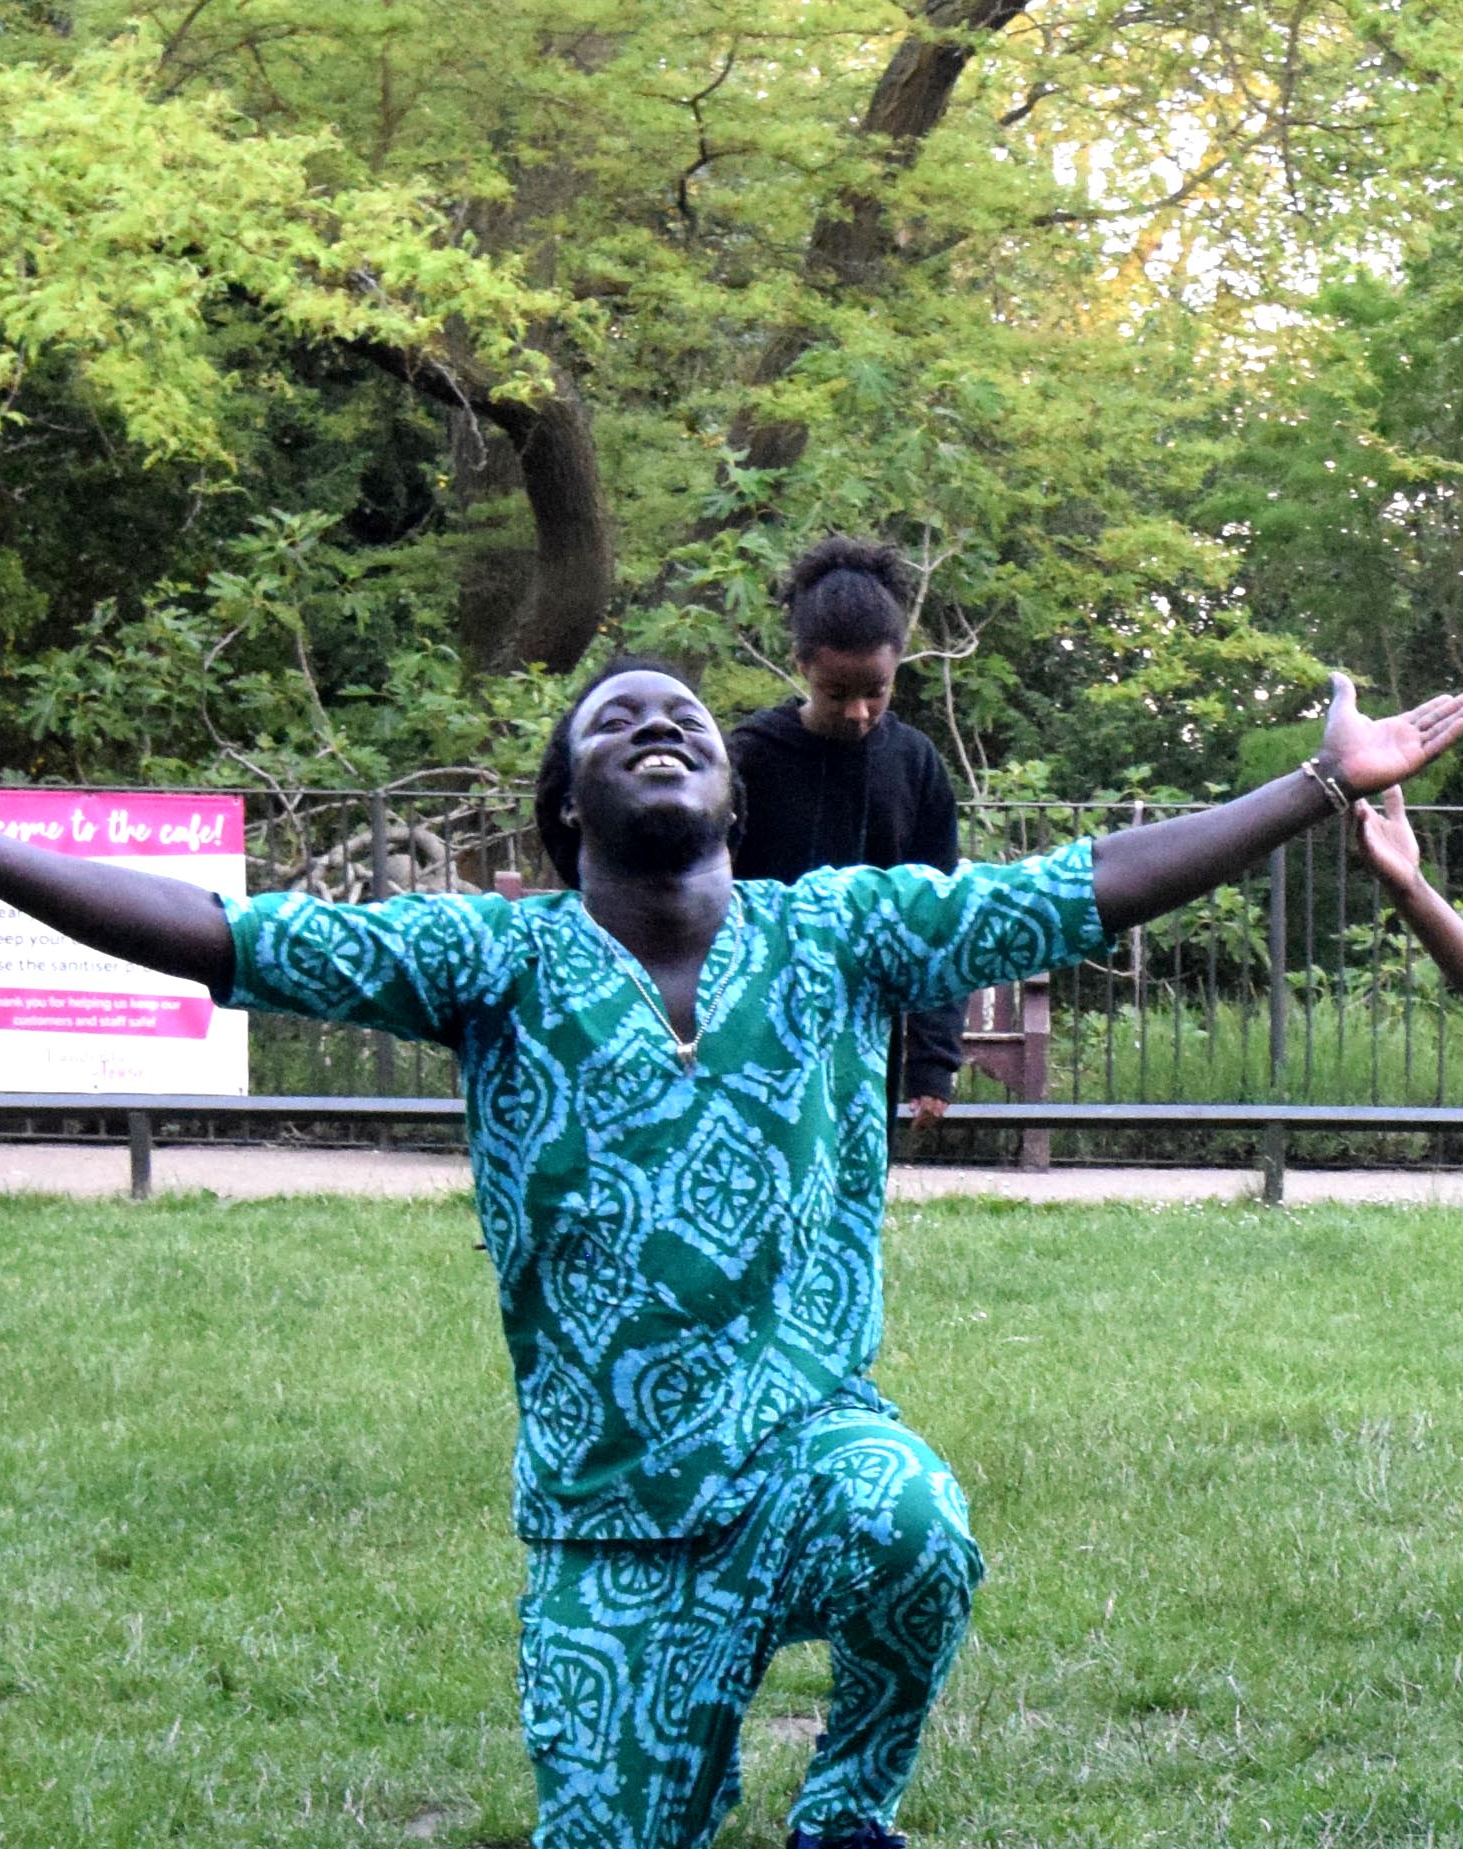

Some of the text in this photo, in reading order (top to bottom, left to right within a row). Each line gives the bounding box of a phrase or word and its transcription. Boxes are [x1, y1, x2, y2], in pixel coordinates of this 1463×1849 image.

[70, 808, 97, 843] to
[107, 809, 152, 844] the
[159, 813, 225, 852] cafe!
[19, 959, 46, 972] the
[51, 959, 118, 973] sanitiser
[24, 998, 47, 1010] you
[12, 1016, 73, 1027] customers
[75, 1016, 98, 1027] and
[98, 1015, 126, 1027] staff
